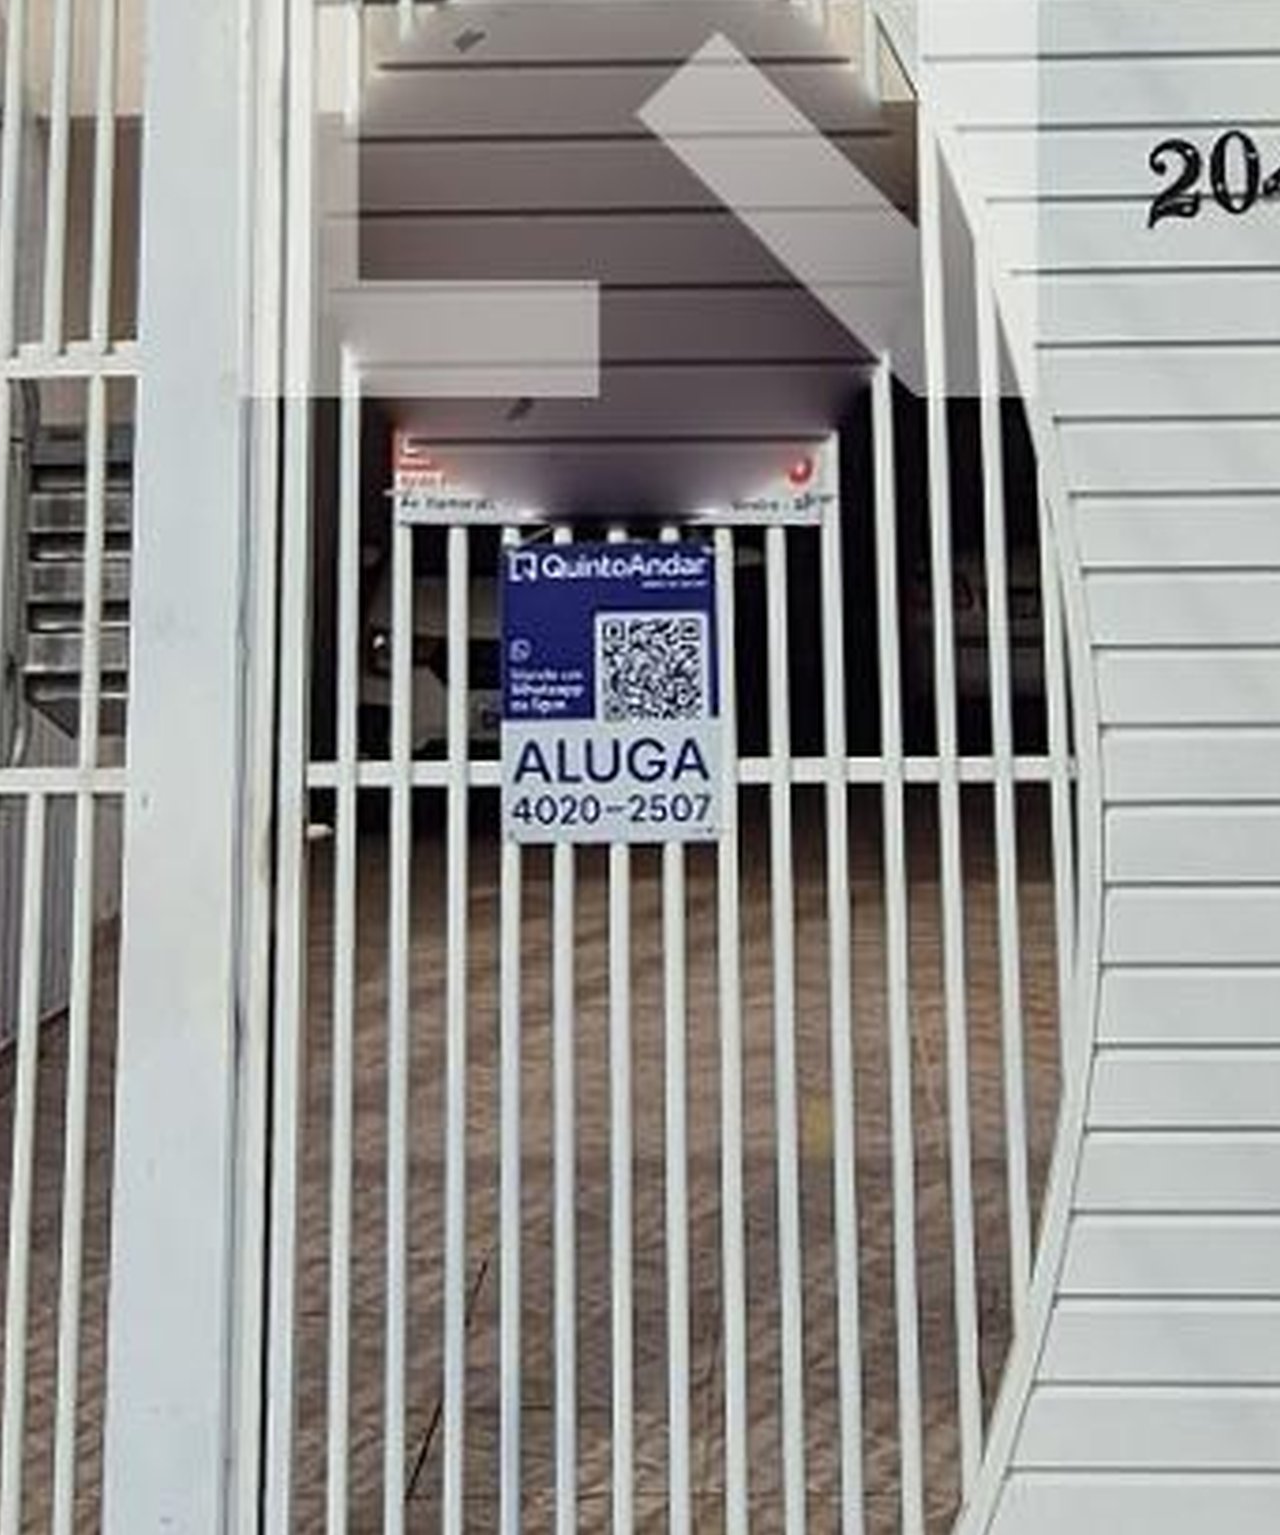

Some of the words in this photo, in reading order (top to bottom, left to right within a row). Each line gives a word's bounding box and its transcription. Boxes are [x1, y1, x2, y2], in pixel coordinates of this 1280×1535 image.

[540, 552, 707, 579] QuintoAndar
[513, 737, 709, 784] ALUGA
[512, 793, 712, 825] 4020-2507
